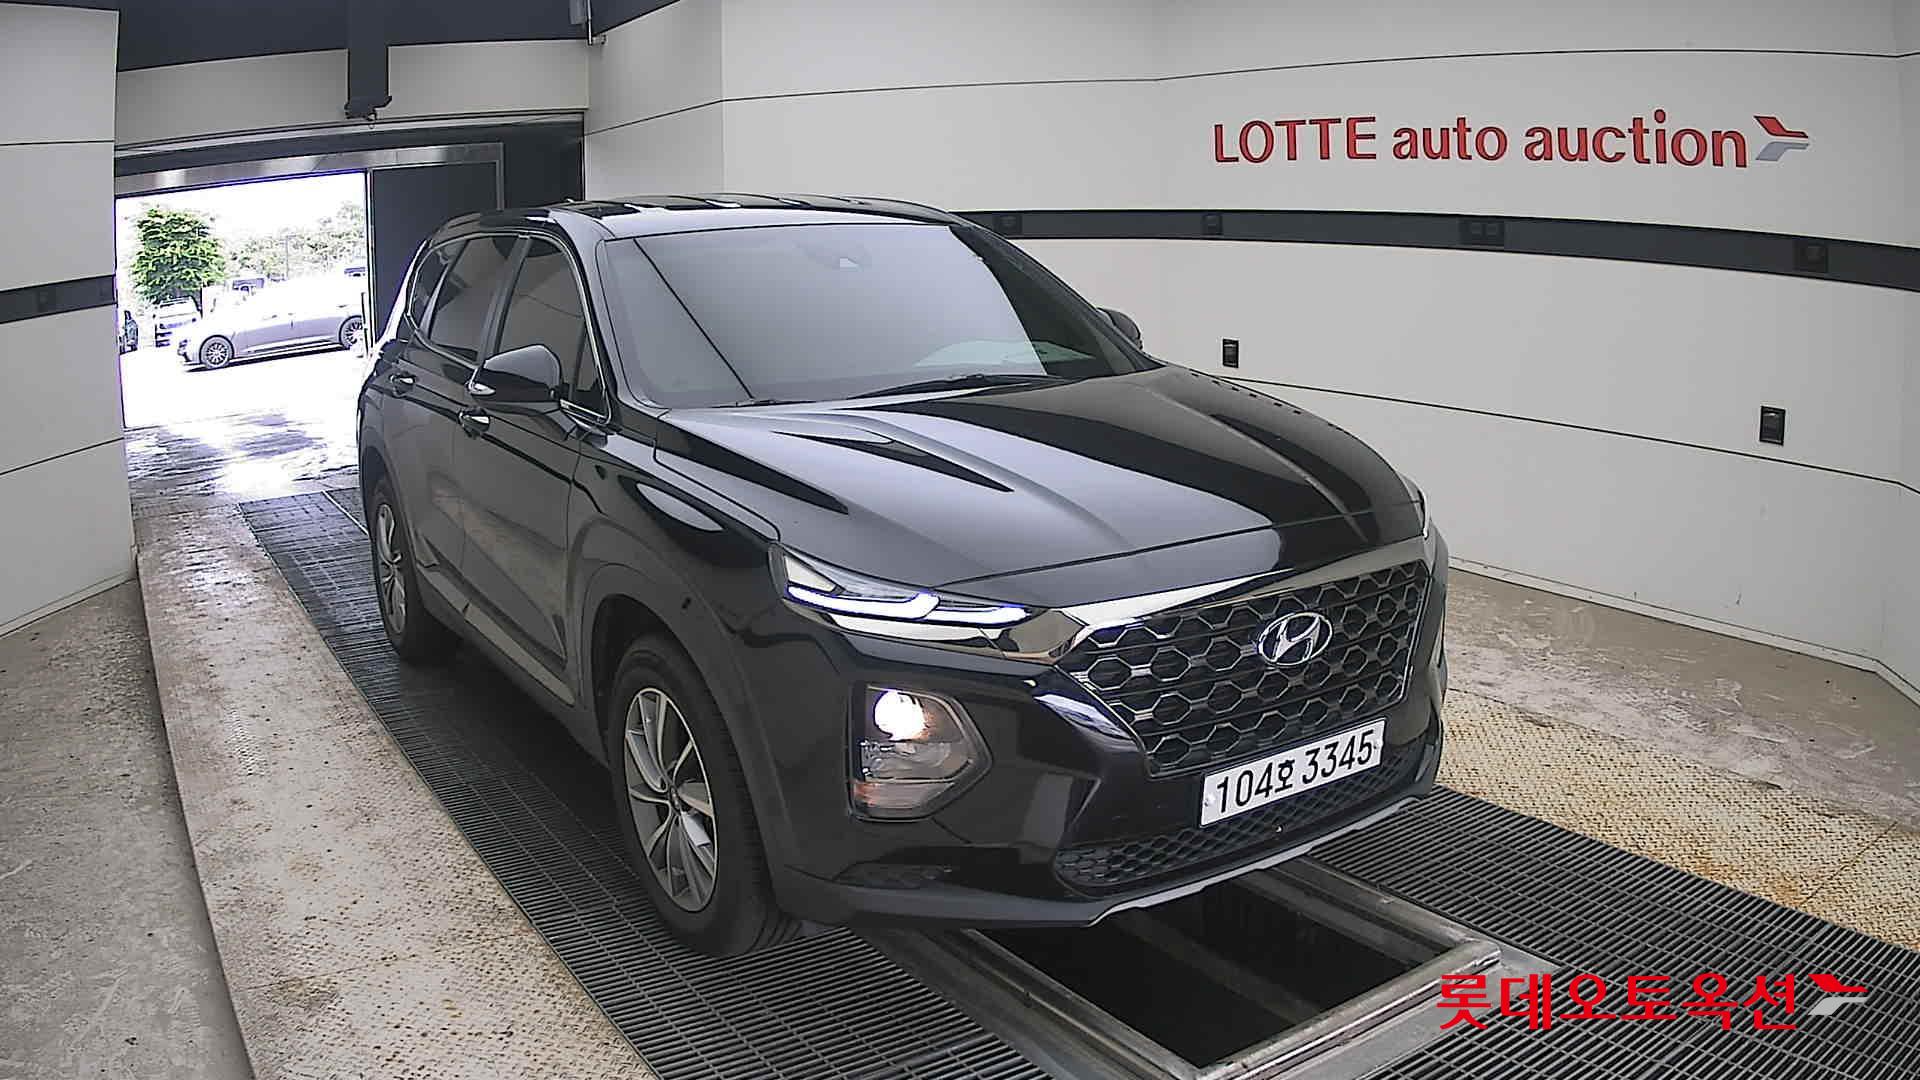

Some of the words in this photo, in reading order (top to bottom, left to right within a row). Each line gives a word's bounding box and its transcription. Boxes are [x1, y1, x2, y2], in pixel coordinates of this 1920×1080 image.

[1214, 116, 1377, 163] LOTTE
[1393, 117, 1508, 161] auto
[1524, 109, 1747, 168] auction
[1302, 729, 1374, 784] 3345
